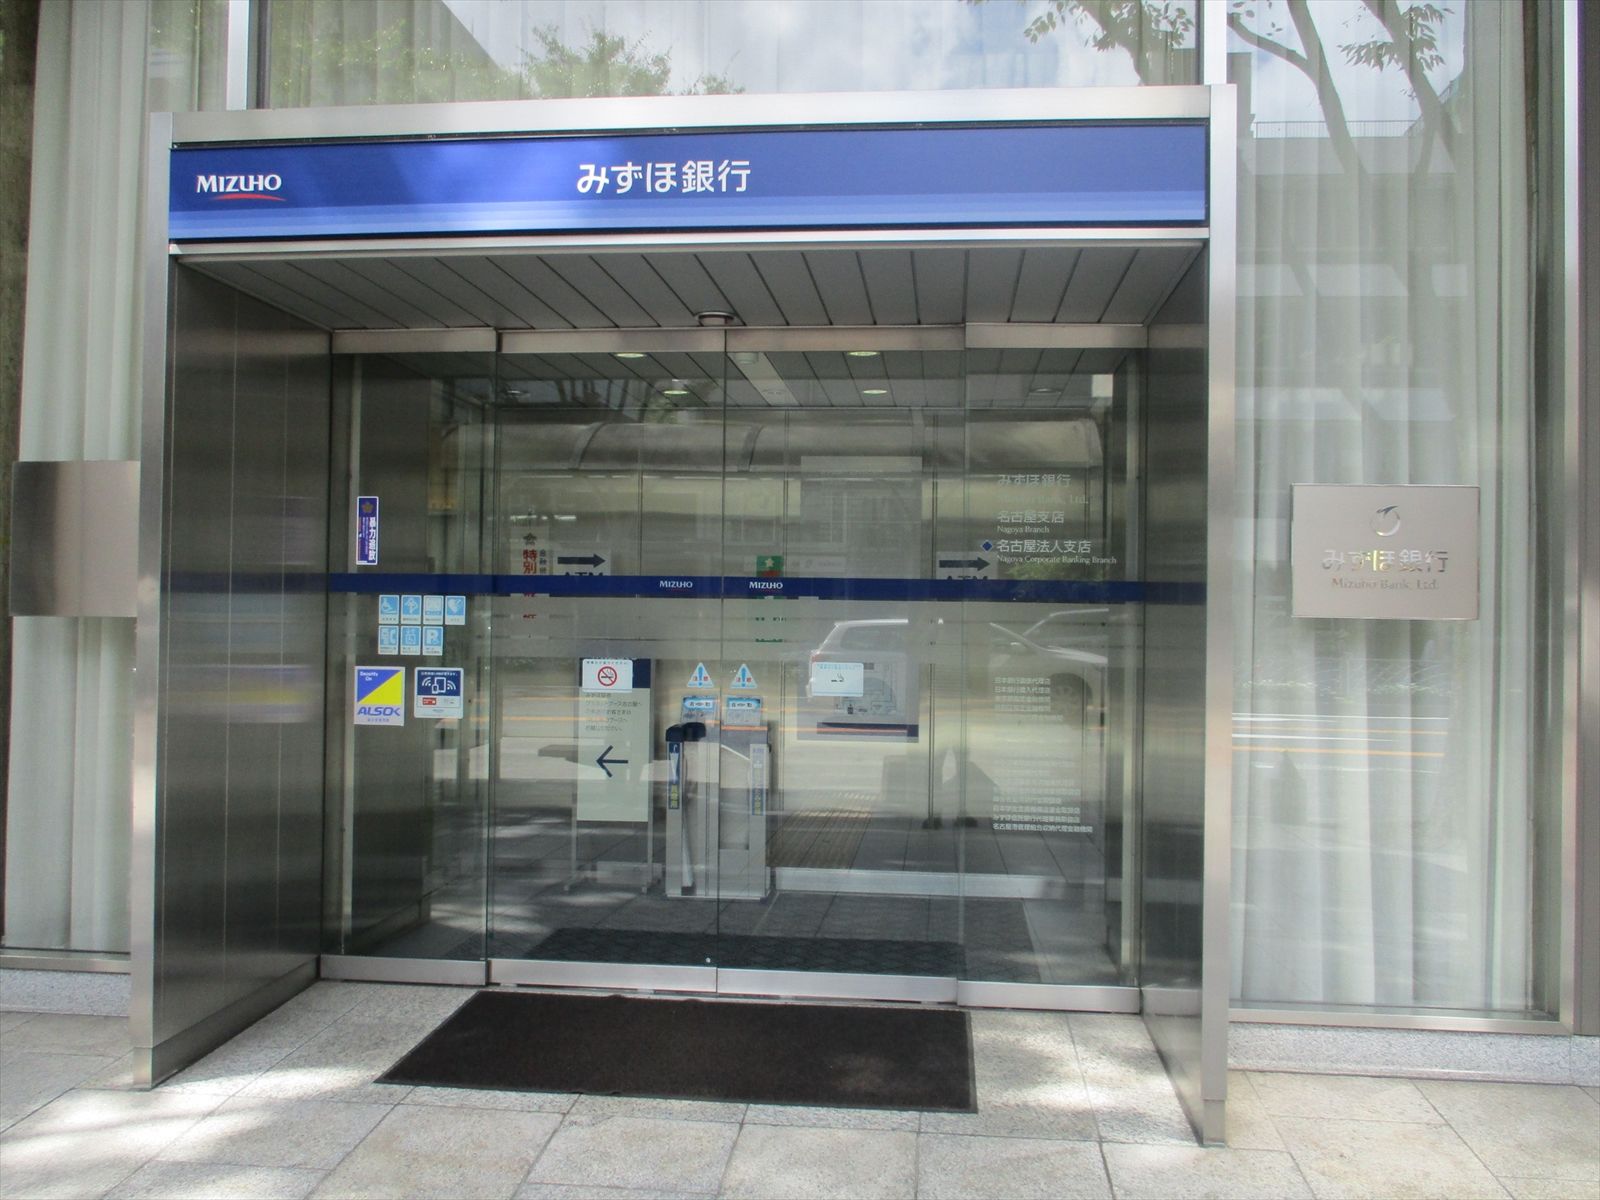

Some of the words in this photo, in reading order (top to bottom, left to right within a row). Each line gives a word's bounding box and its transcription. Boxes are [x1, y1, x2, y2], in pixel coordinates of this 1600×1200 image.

[196, 173, 283, 194] MIZUHO
[576, 159, 752, 196] みずほ銀行
[998, 474, 1072, 488] みずほ銀行
[997, 509, 1065, 524] 名古屋支店
[997, 526, 1023, 535] Nagoya
[1025, 526, 1050, 534] Branch
[997, 539, 1092, 554] 名古屋法人支店
[997, 555, 1023, 564] Nagoya
[1026, 555, 1060, 564] Corporate
[1062, 556, 1091, 565] Banking
[1092, 556, 1117, 564] Branch
[1322, 549, 1450, 573] みずほ銀行
[659, 580, 693, 590] MIZUHO
[749, 580, 783, 590] MIZUHO
[1331, 577, 1377, 590] Mizuho
[357, 706, 401, 717] ALSOK
